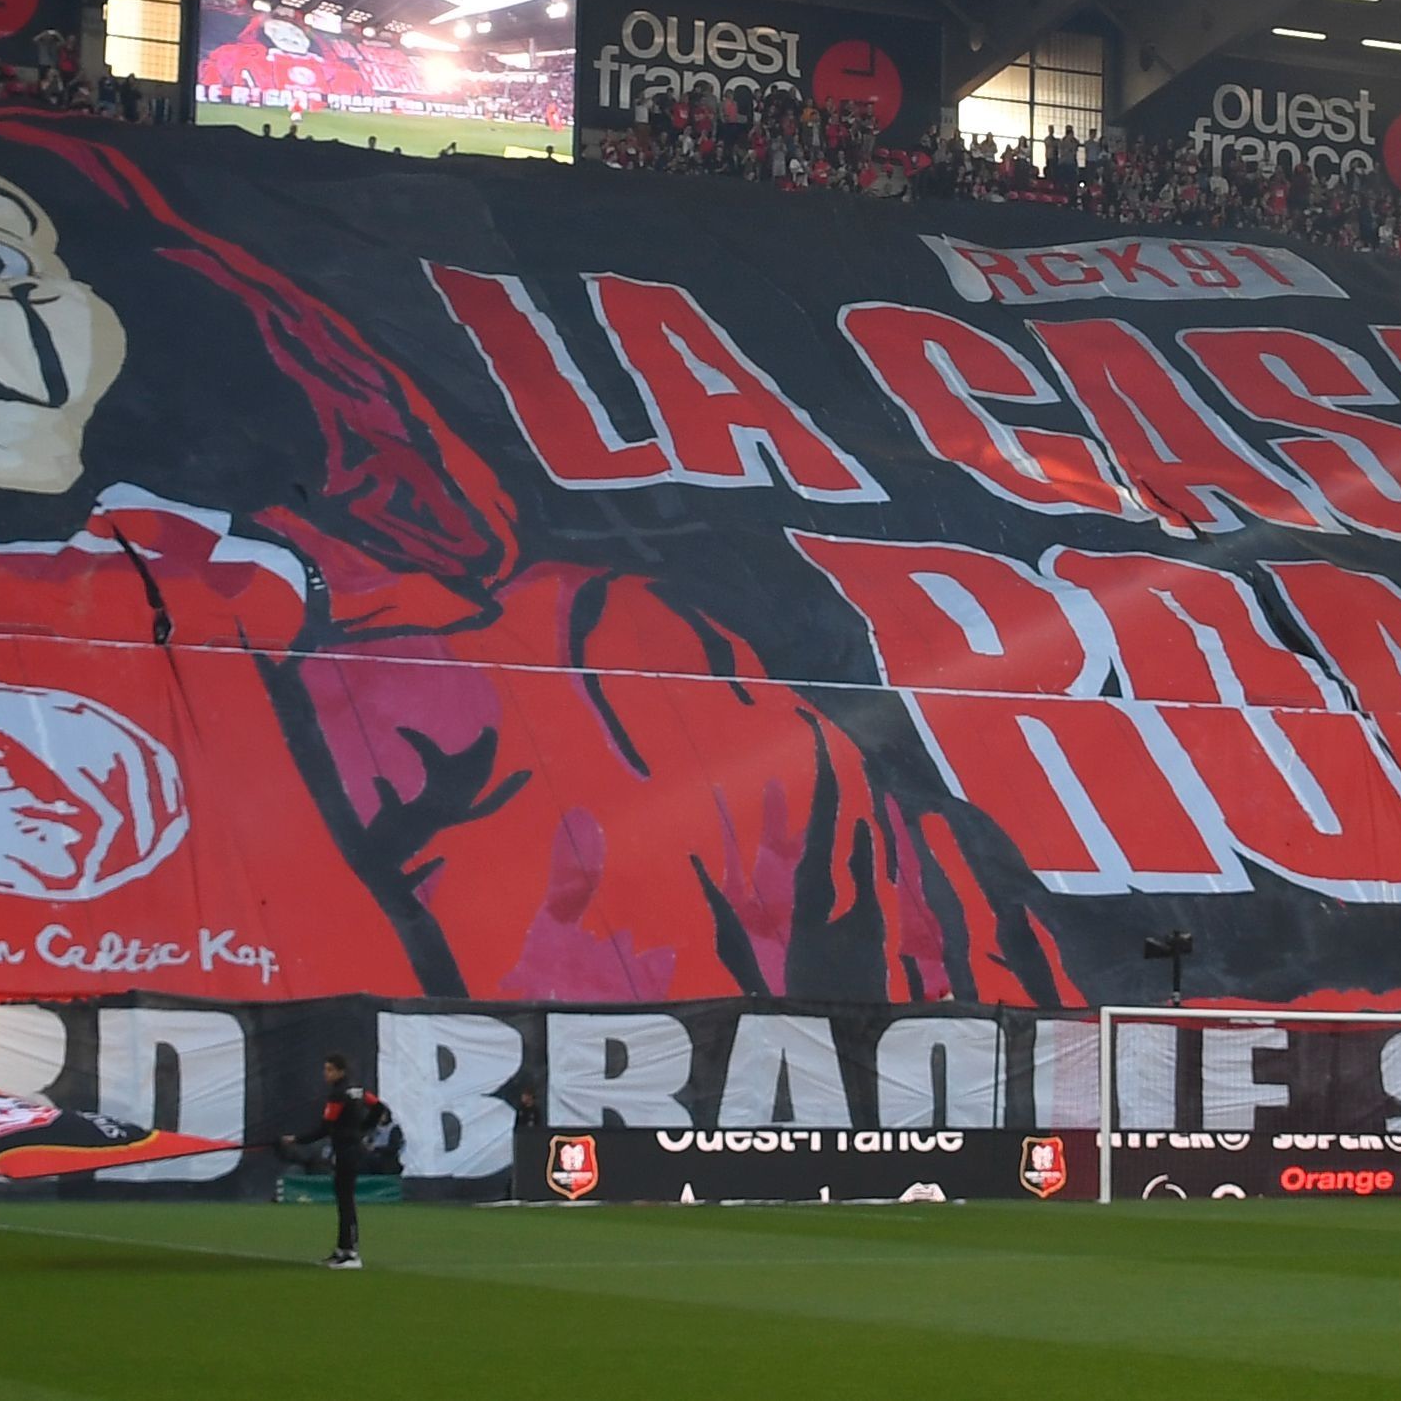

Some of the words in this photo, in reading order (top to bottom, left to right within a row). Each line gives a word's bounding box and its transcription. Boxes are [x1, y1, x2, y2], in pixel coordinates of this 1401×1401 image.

[621, 9, 802, 78] ouest
[1212, 83, 1376, 146] ouest
[419, 257, 892, 502] LA
[1279, 1164, 1395, 1195] Orange
